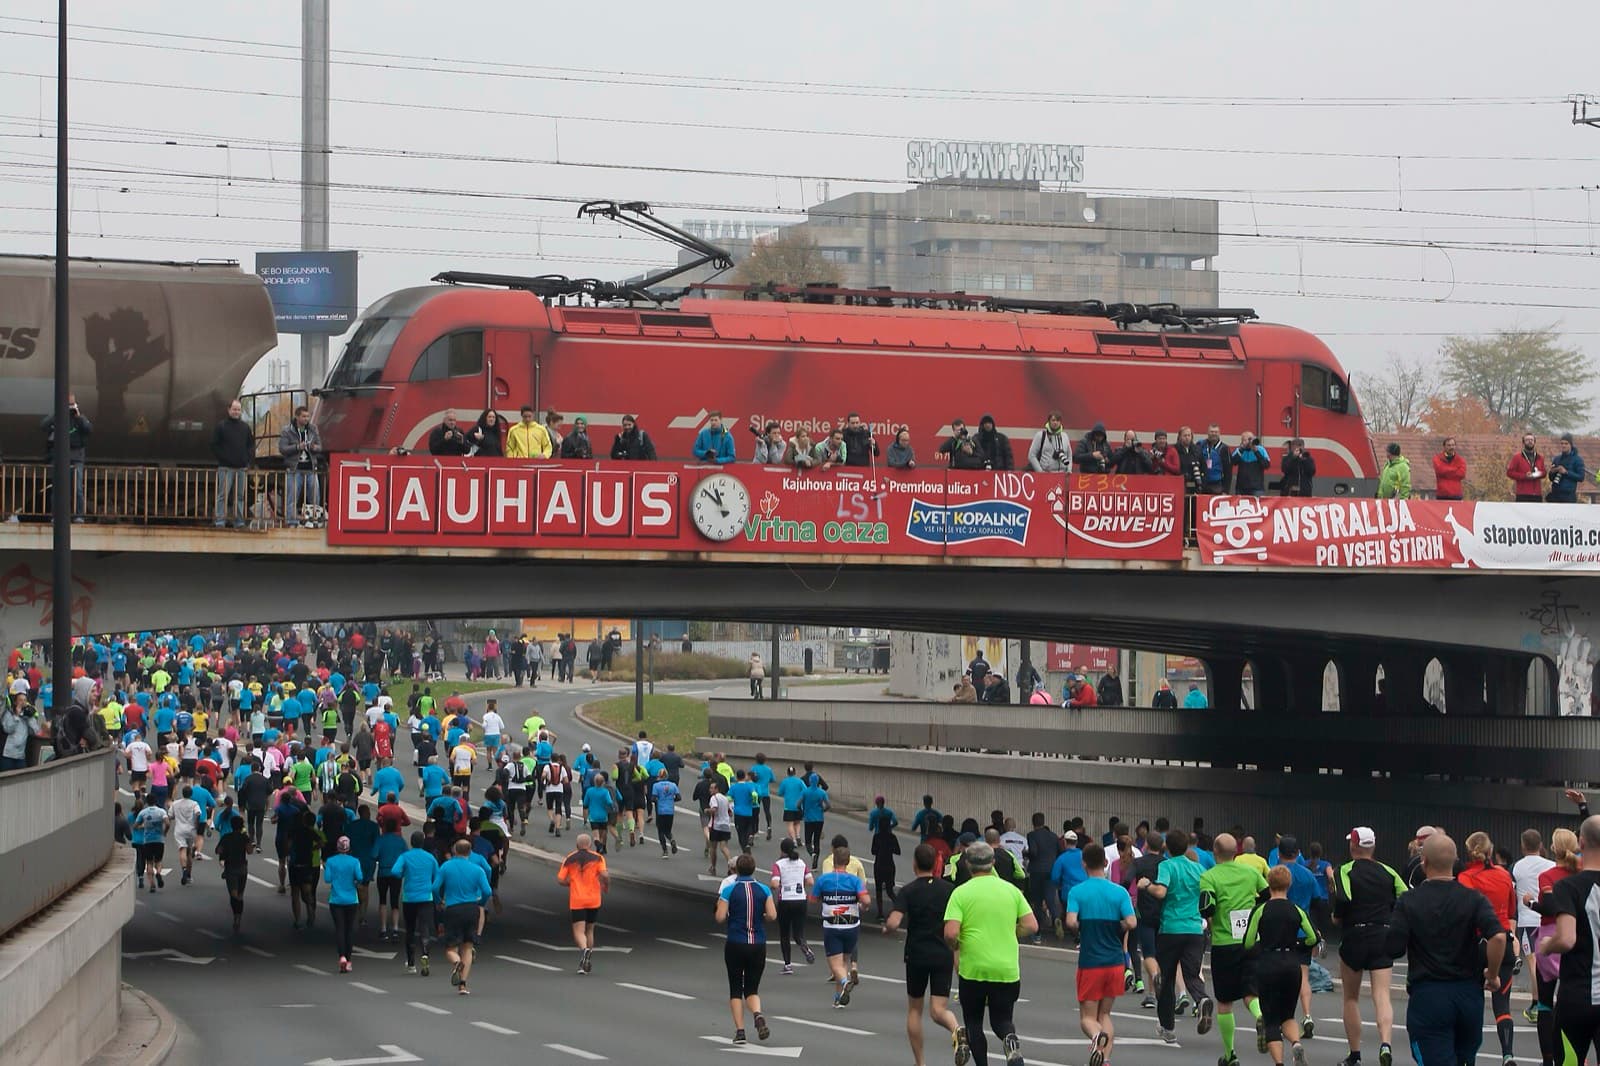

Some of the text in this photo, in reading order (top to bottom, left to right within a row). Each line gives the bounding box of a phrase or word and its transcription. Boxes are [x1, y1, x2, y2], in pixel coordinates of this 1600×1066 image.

[907, 140, 1085, 183] SLOVENIJALES
[0, 326, 41, 360] S
[348, 475, 673, 526] BAUHAUS
[782, 477, 832, 493] Kajuhova
[835, 479, 860, 492] ulica
[889, 480, 944, 493] Premrlova
[947, 482, 971, 495] ulica
[973, 483, 979, 495] 1
[994, 473, 1036, 500] NDC
[837, 491, 888, 520] LST
[912, 509, 1025, 527] SVET KOPALNIC
[1071, 494, 1174, 513] BAUHAUS
[744, 514, 890, 543] Vrtna oaza
[1082, 515, 1175, 533] DRIVE-IN
[1273, 498, 1416, 544] AVSTRALIJA
[1316, 534, 1445, 567] PO VSEH ŠTIRIH
